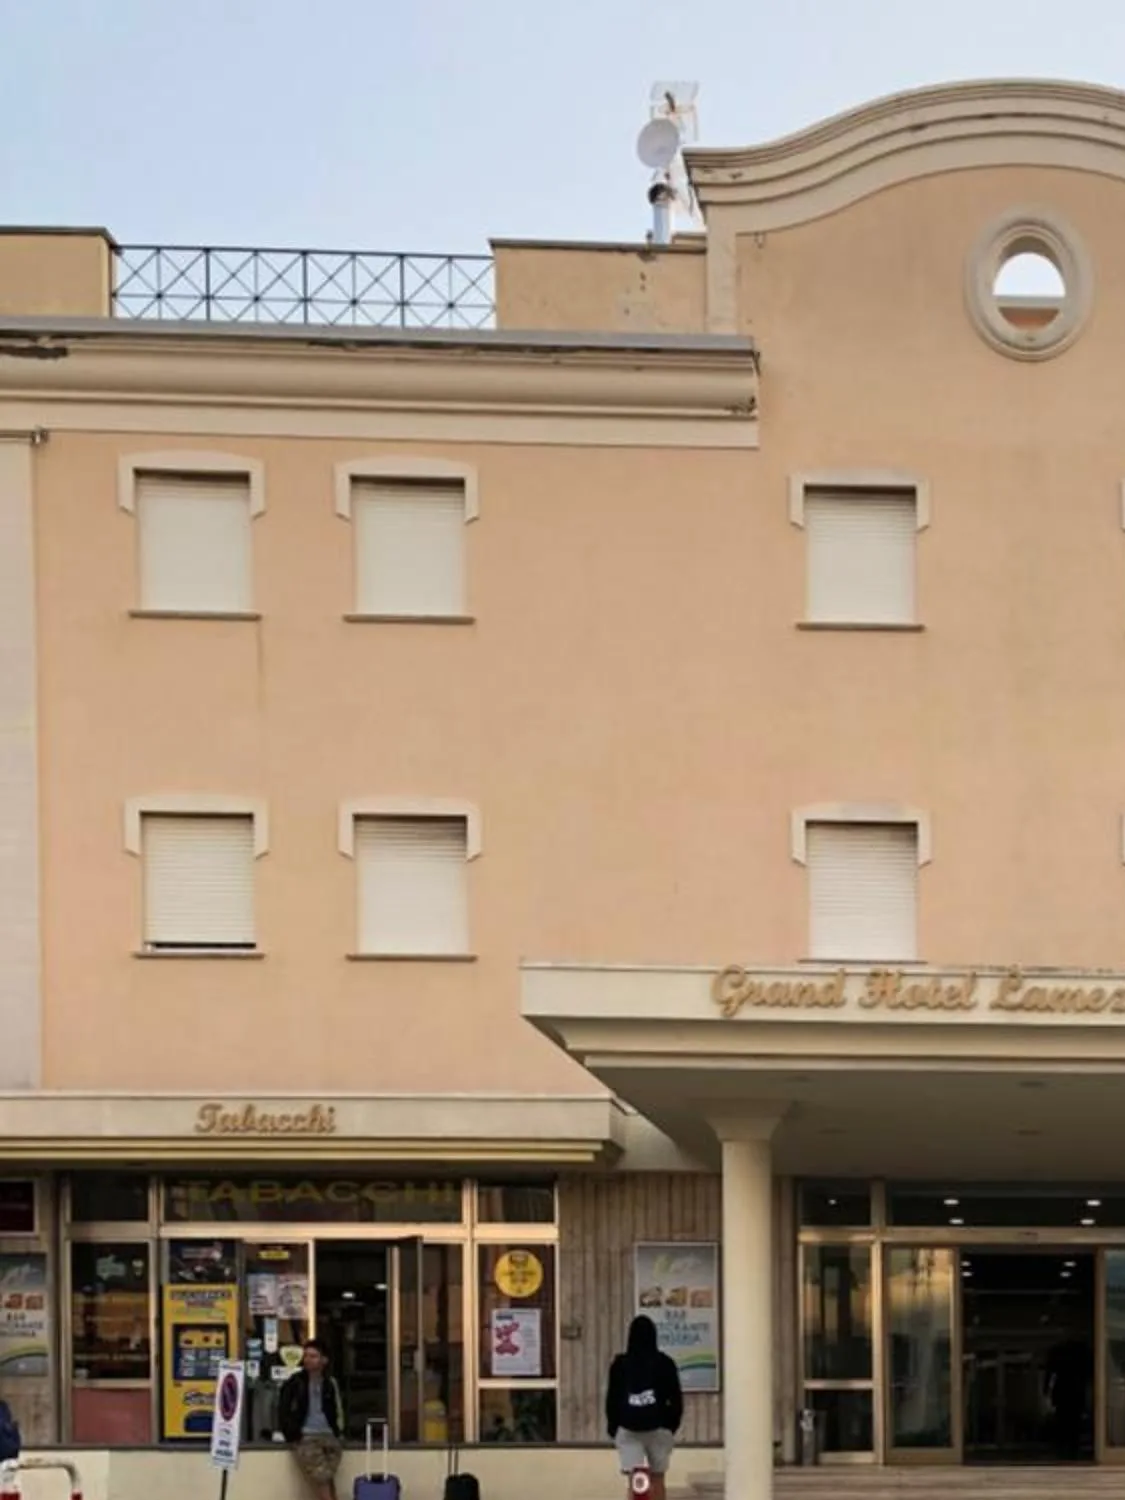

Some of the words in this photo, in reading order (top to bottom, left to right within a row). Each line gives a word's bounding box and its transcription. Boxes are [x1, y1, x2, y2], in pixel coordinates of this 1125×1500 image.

[711, 964, 848, 1018] Grand
[857, 967, 979, 1012] Hotel
[194, 1103, 337, 1134] Tabacchi
[178, 1180, 455, 1205] TABACCHI
